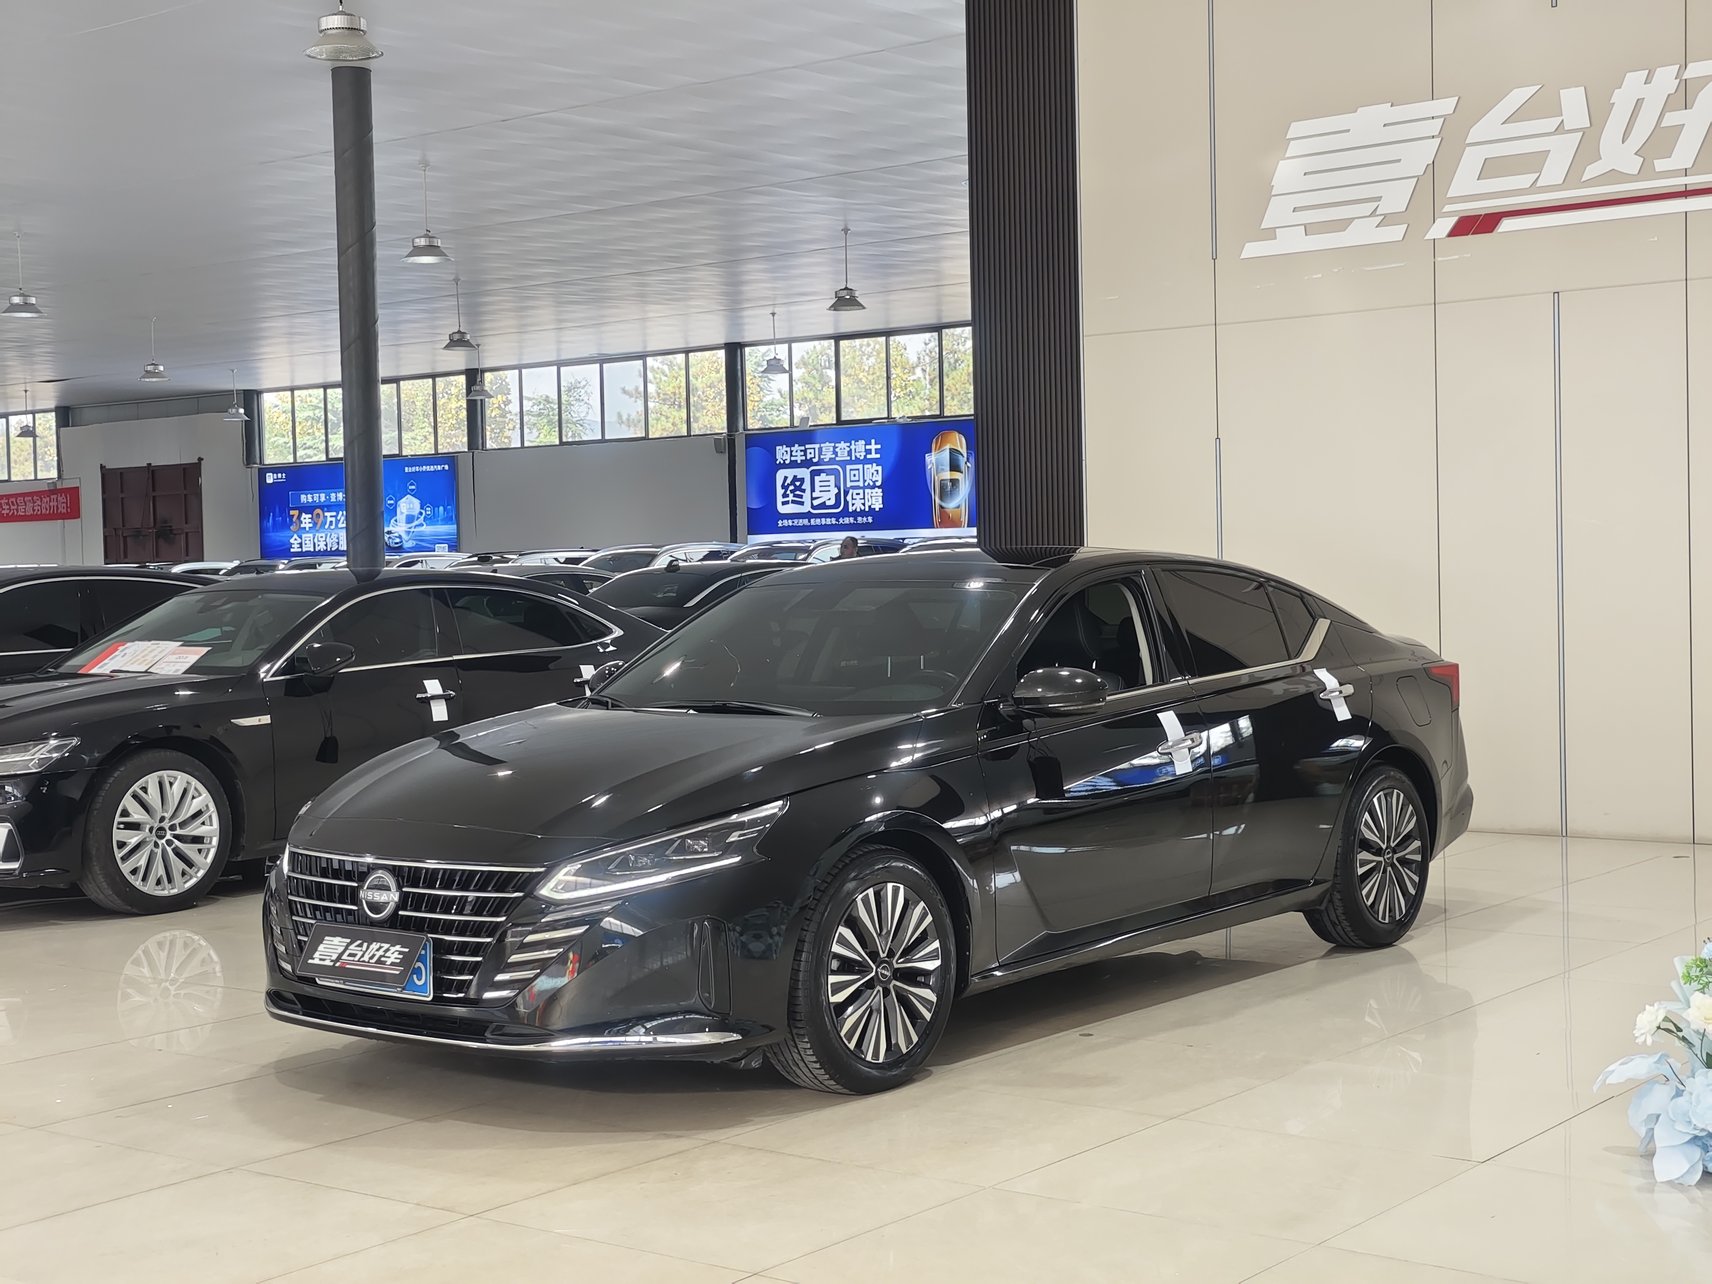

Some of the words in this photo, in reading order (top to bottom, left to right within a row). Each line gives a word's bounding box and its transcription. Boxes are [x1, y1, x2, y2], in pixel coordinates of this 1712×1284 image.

[1240, 59, 1712, 259] 壹台好
[776, 439, 881, 464] 购车可享查博士
[846, 463, 883, 487] 回购
[780, 472, 839, 507] 终身
[846, 489, 884, 512] 保障
[0, 494, 70, 517] 车只是服务的开始！
[359, 890, 400, 903] NISSAN
[308, 935, 409, 966] 壹台好车
